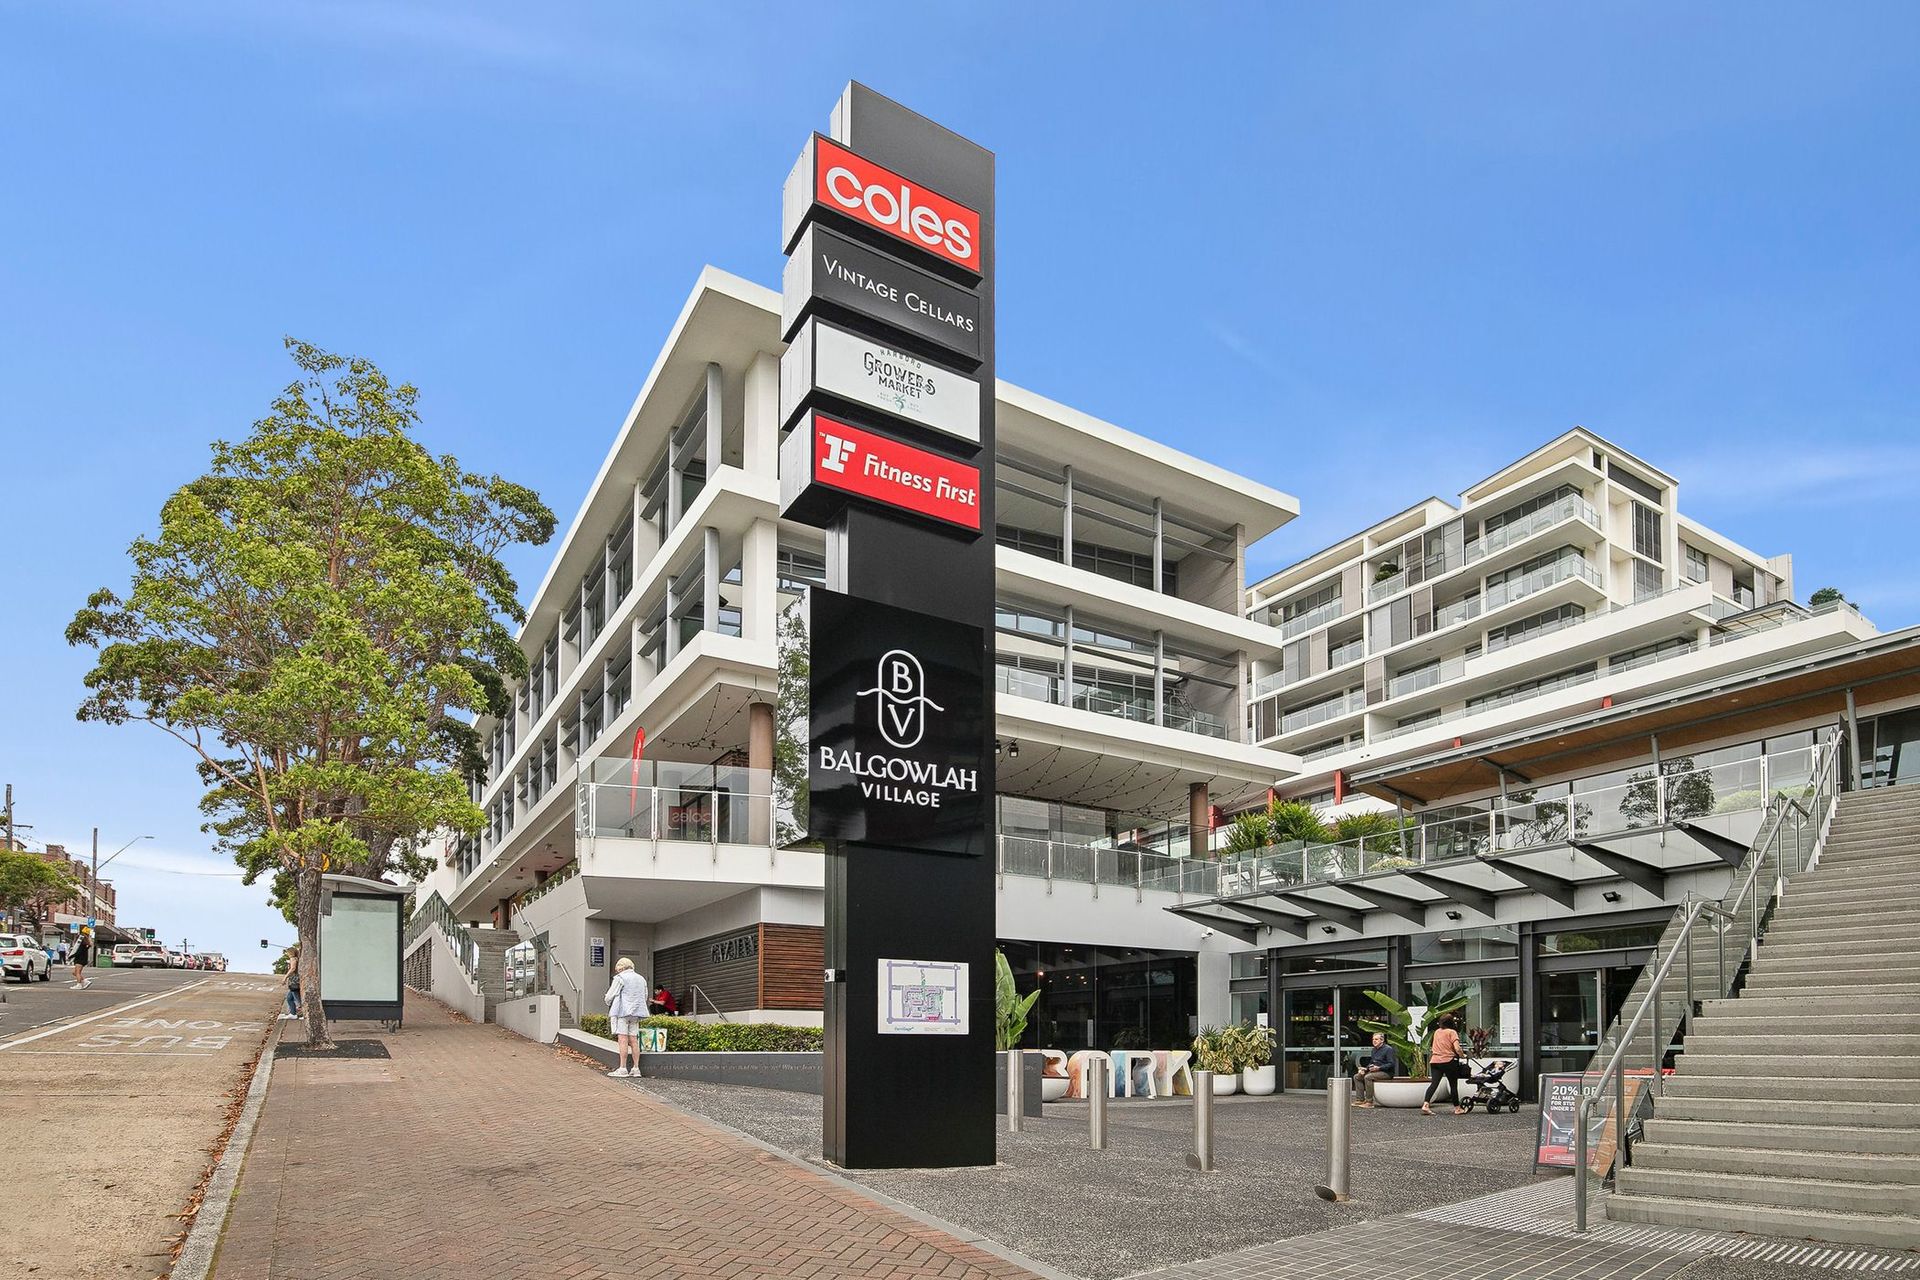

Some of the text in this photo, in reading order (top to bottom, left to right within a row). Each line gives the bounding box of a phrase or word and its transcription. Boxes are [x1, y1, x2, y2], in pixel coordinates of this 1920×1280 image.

[826, 166, 972, 259] coles
[822, 254, 974, 333] VINTAGE CELLARS
[864, 351, 936, 396] GROWERS
[878, 375, 922, 399] MARKET
[863, 452, 932, 492] Fitness
[935, 475, 977, 506] First
[892, 660, 913, 694] B
[887, 703, 916, 738] V
[820, 745, 978, 792] BALGOWLAH
[861, 781, 941, 808] VILLAGE
[97, 1017, 264, 1031] ZONE
[78, 1034, 233, 1050] BUS
[1552, 1085, 1598, 1096] 20% OF
